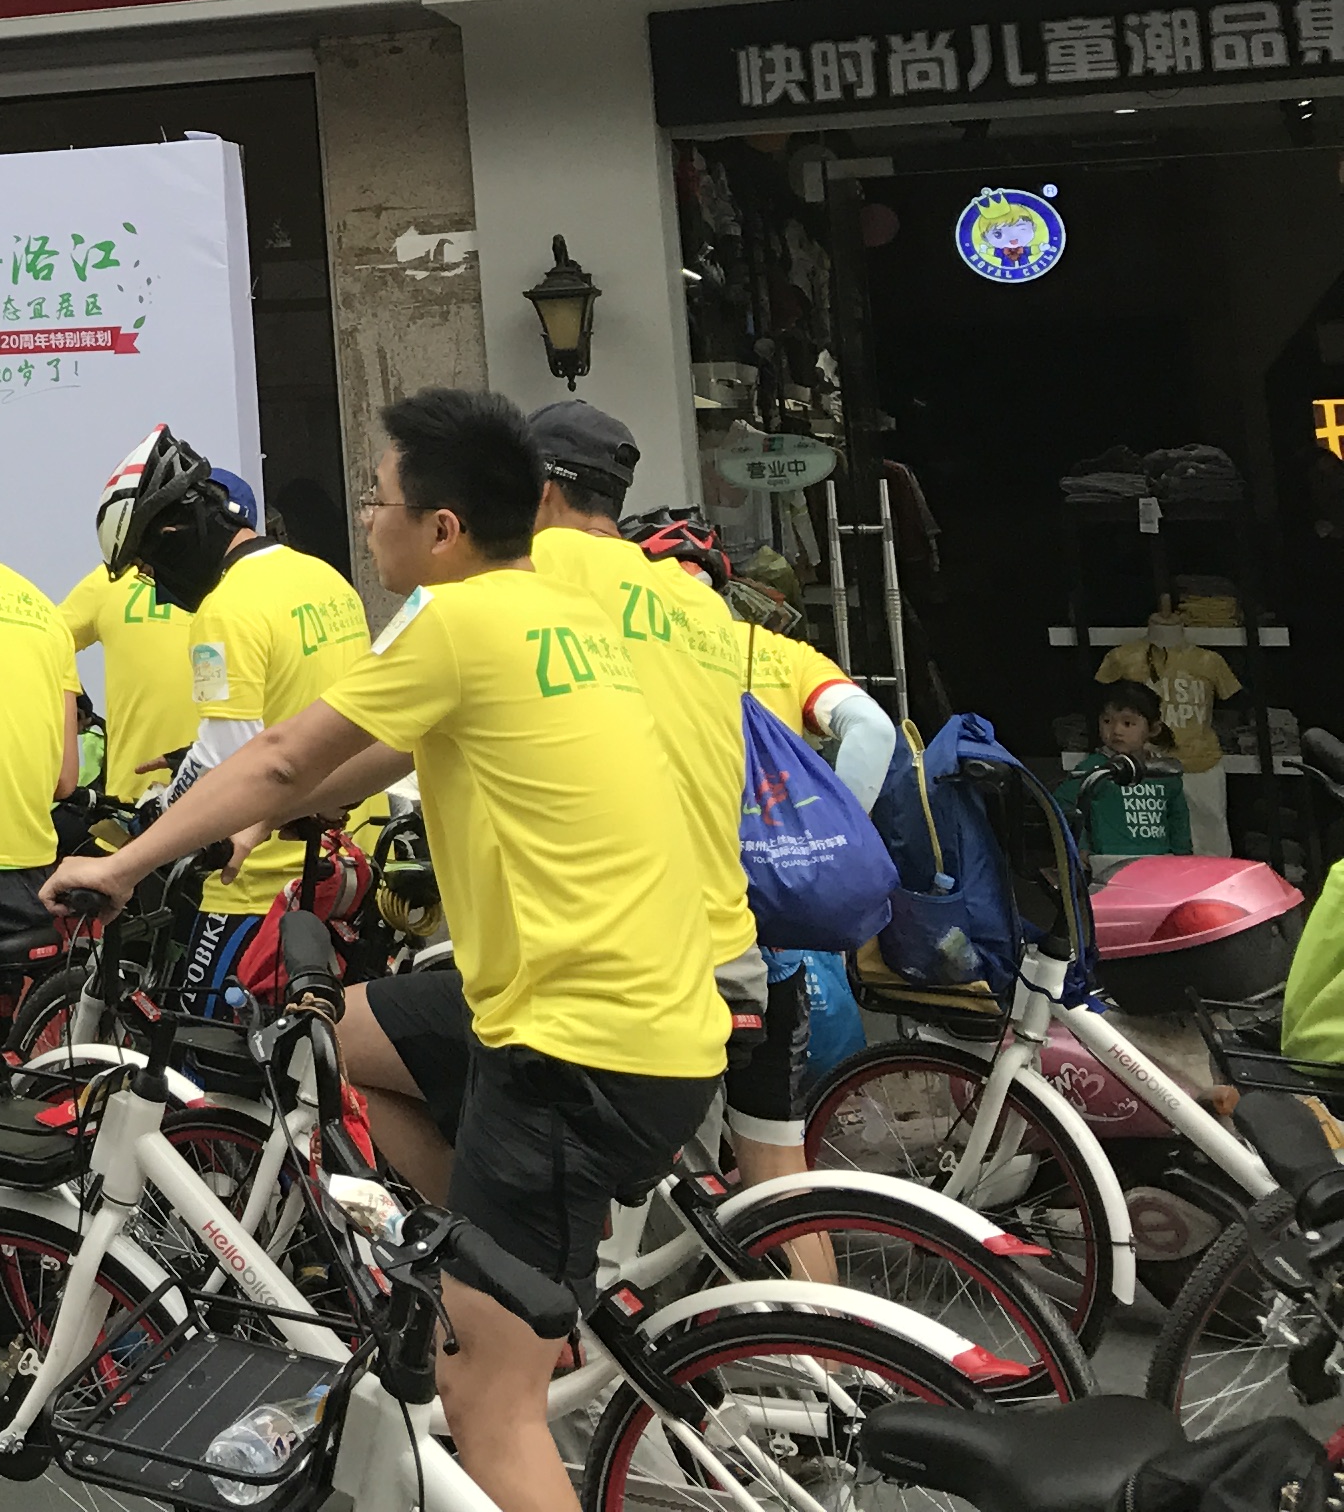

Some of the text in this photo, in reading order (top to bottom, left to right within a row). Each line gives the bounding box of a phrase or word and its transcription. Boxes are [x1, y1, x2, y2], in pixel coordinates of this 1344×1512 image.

[746, 459, 806, 479] 营业中
[1125, 812, 1162, 825] NEW
[1127, 825, 1166, 838] YORK
[1107, 1043, 1180, 1110] Hellobike
